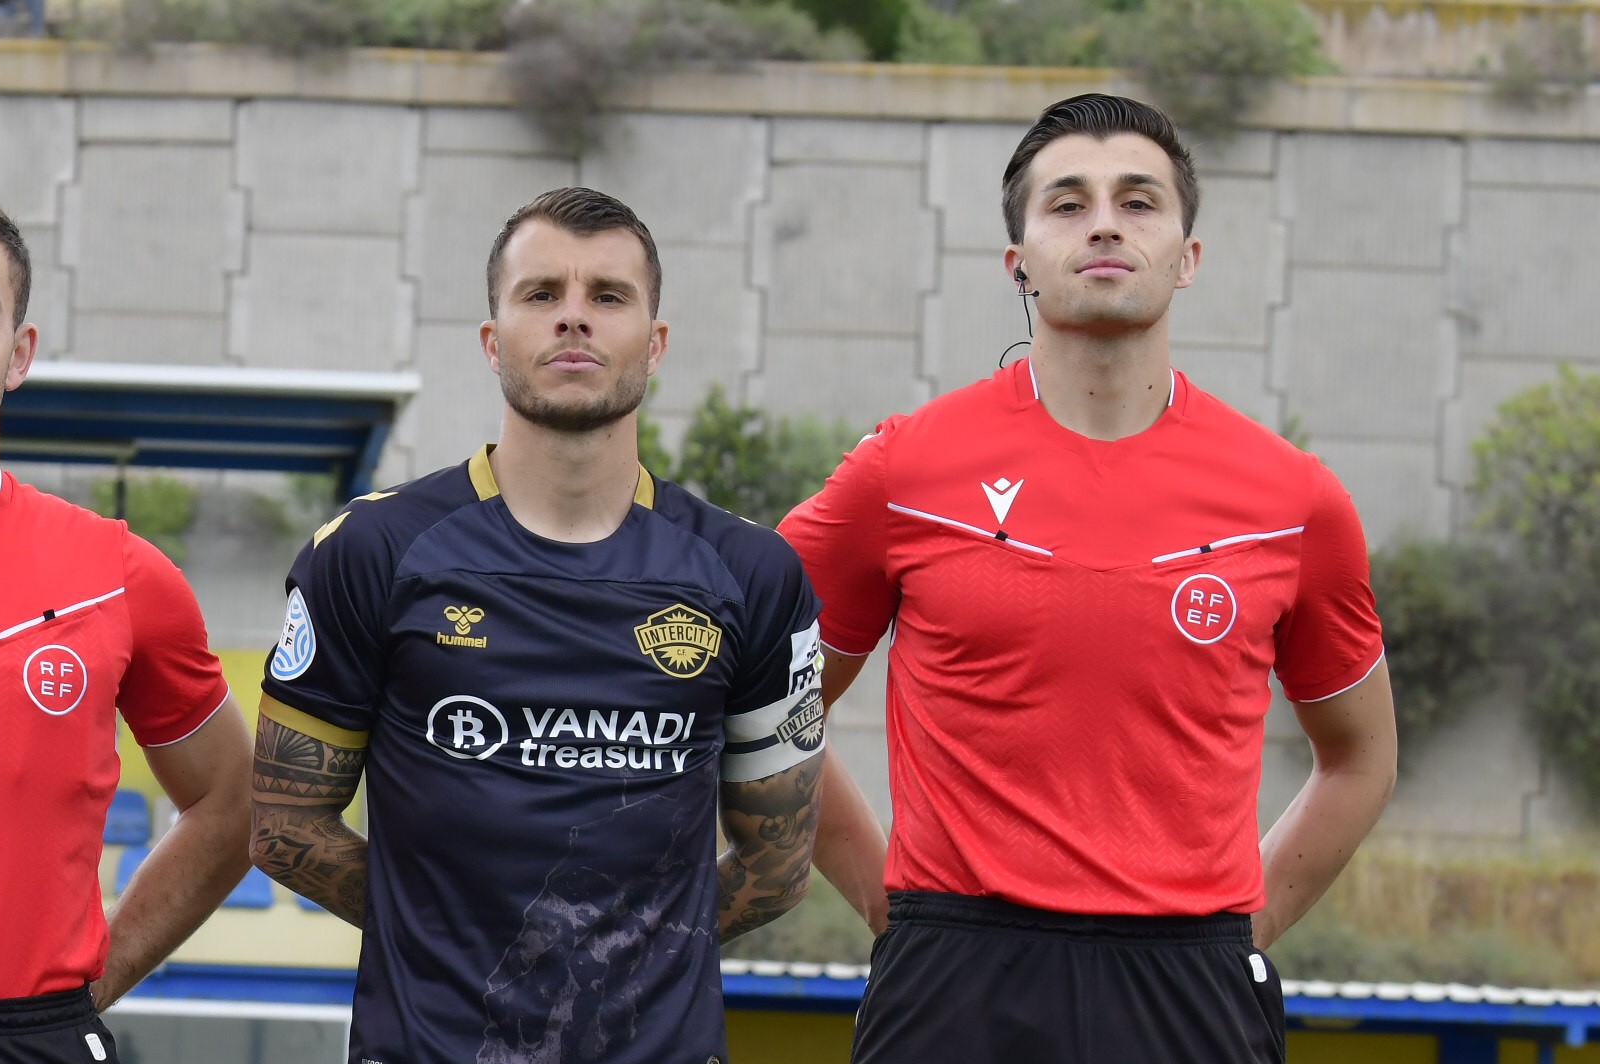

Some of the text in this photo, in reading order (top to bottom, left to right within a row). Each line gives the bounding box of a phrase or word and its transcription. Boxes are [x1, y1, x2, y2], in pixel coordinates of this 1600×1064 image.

[436, 631, 487, 649] hummel
[644, 625, 715, 648] INTERCITY
[521, 706, 697, 746] VANADI
[519, 738, 694, 774] treasury
